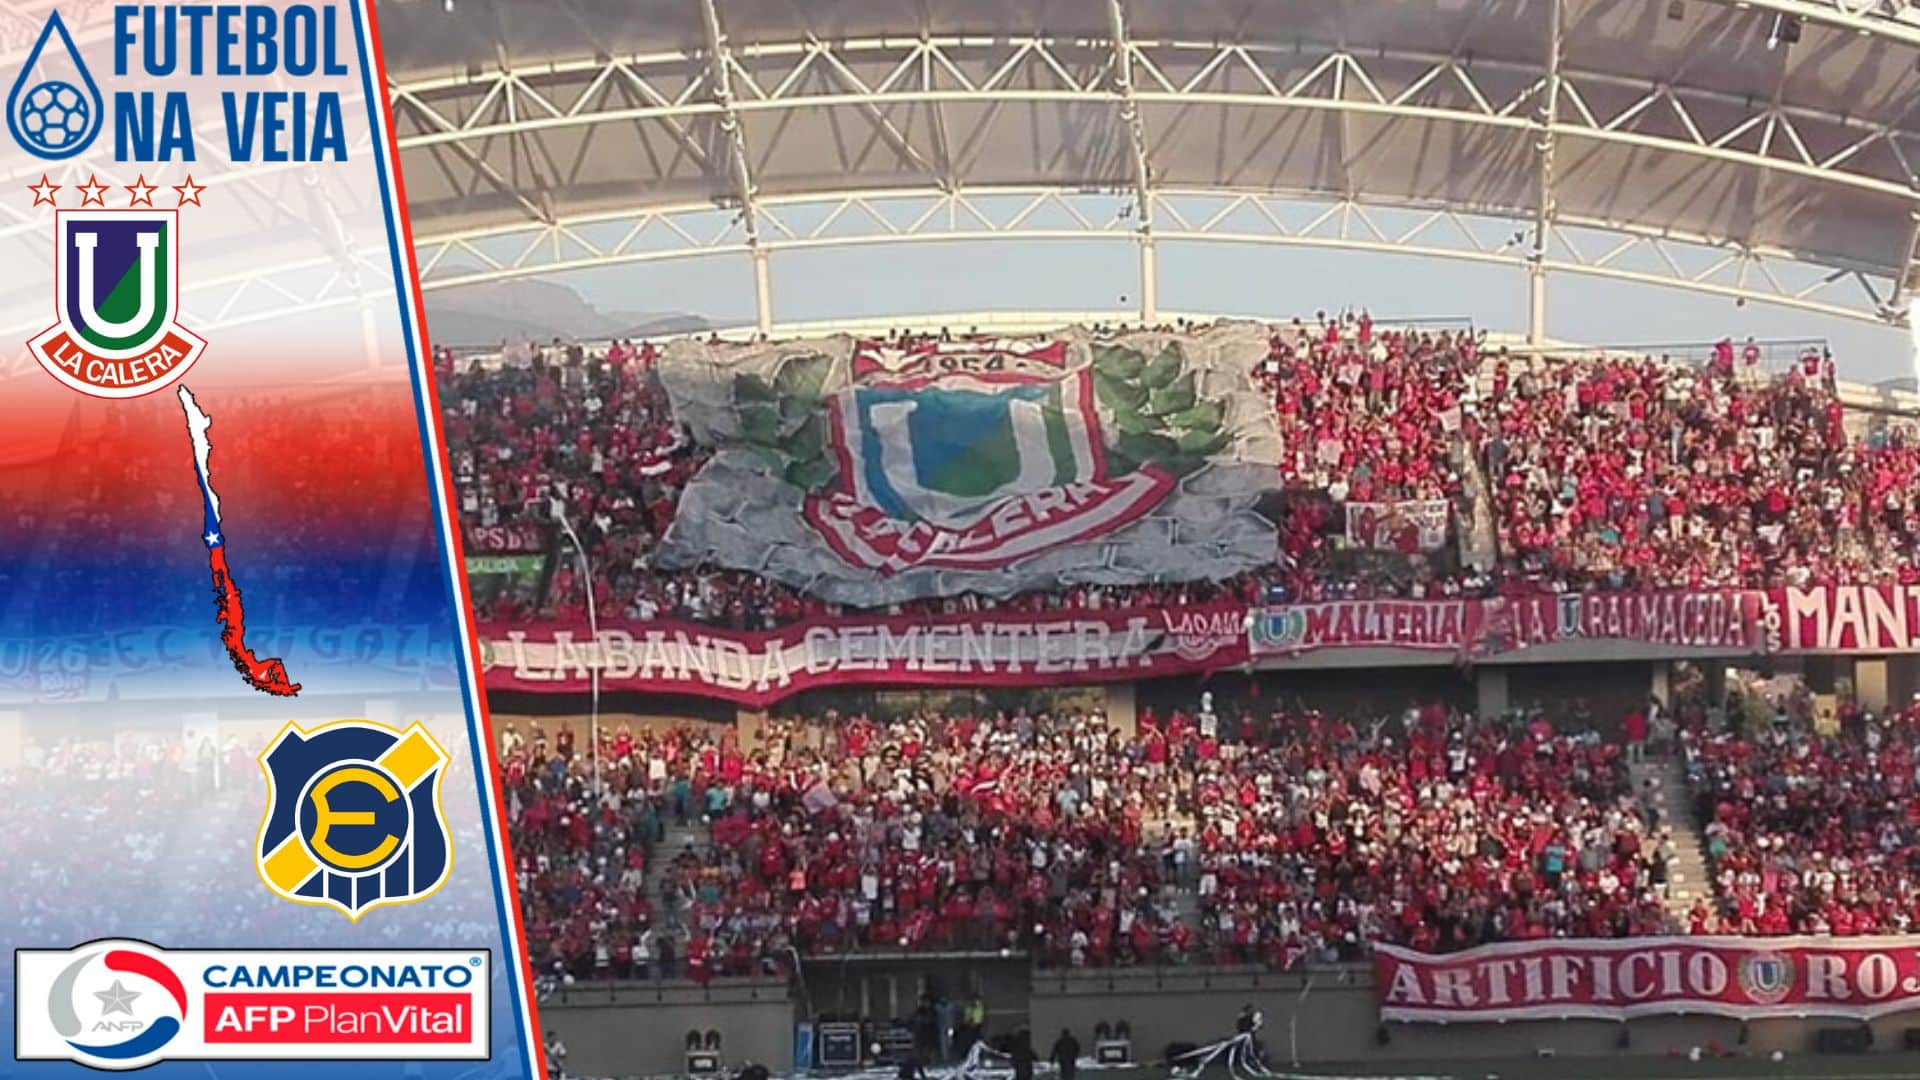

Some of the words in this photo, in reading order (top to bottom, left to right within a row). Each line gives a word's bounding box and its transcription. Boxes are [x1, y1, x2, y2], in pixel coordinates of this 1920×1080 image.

[1303, 601, 1462, 645] MALTERIA
[594, 629, 793, 692] BANDA
[802, 616, 1155, 675] CEMENTERA
[1387, 950, 1728, 1006] ARTIFICIO
